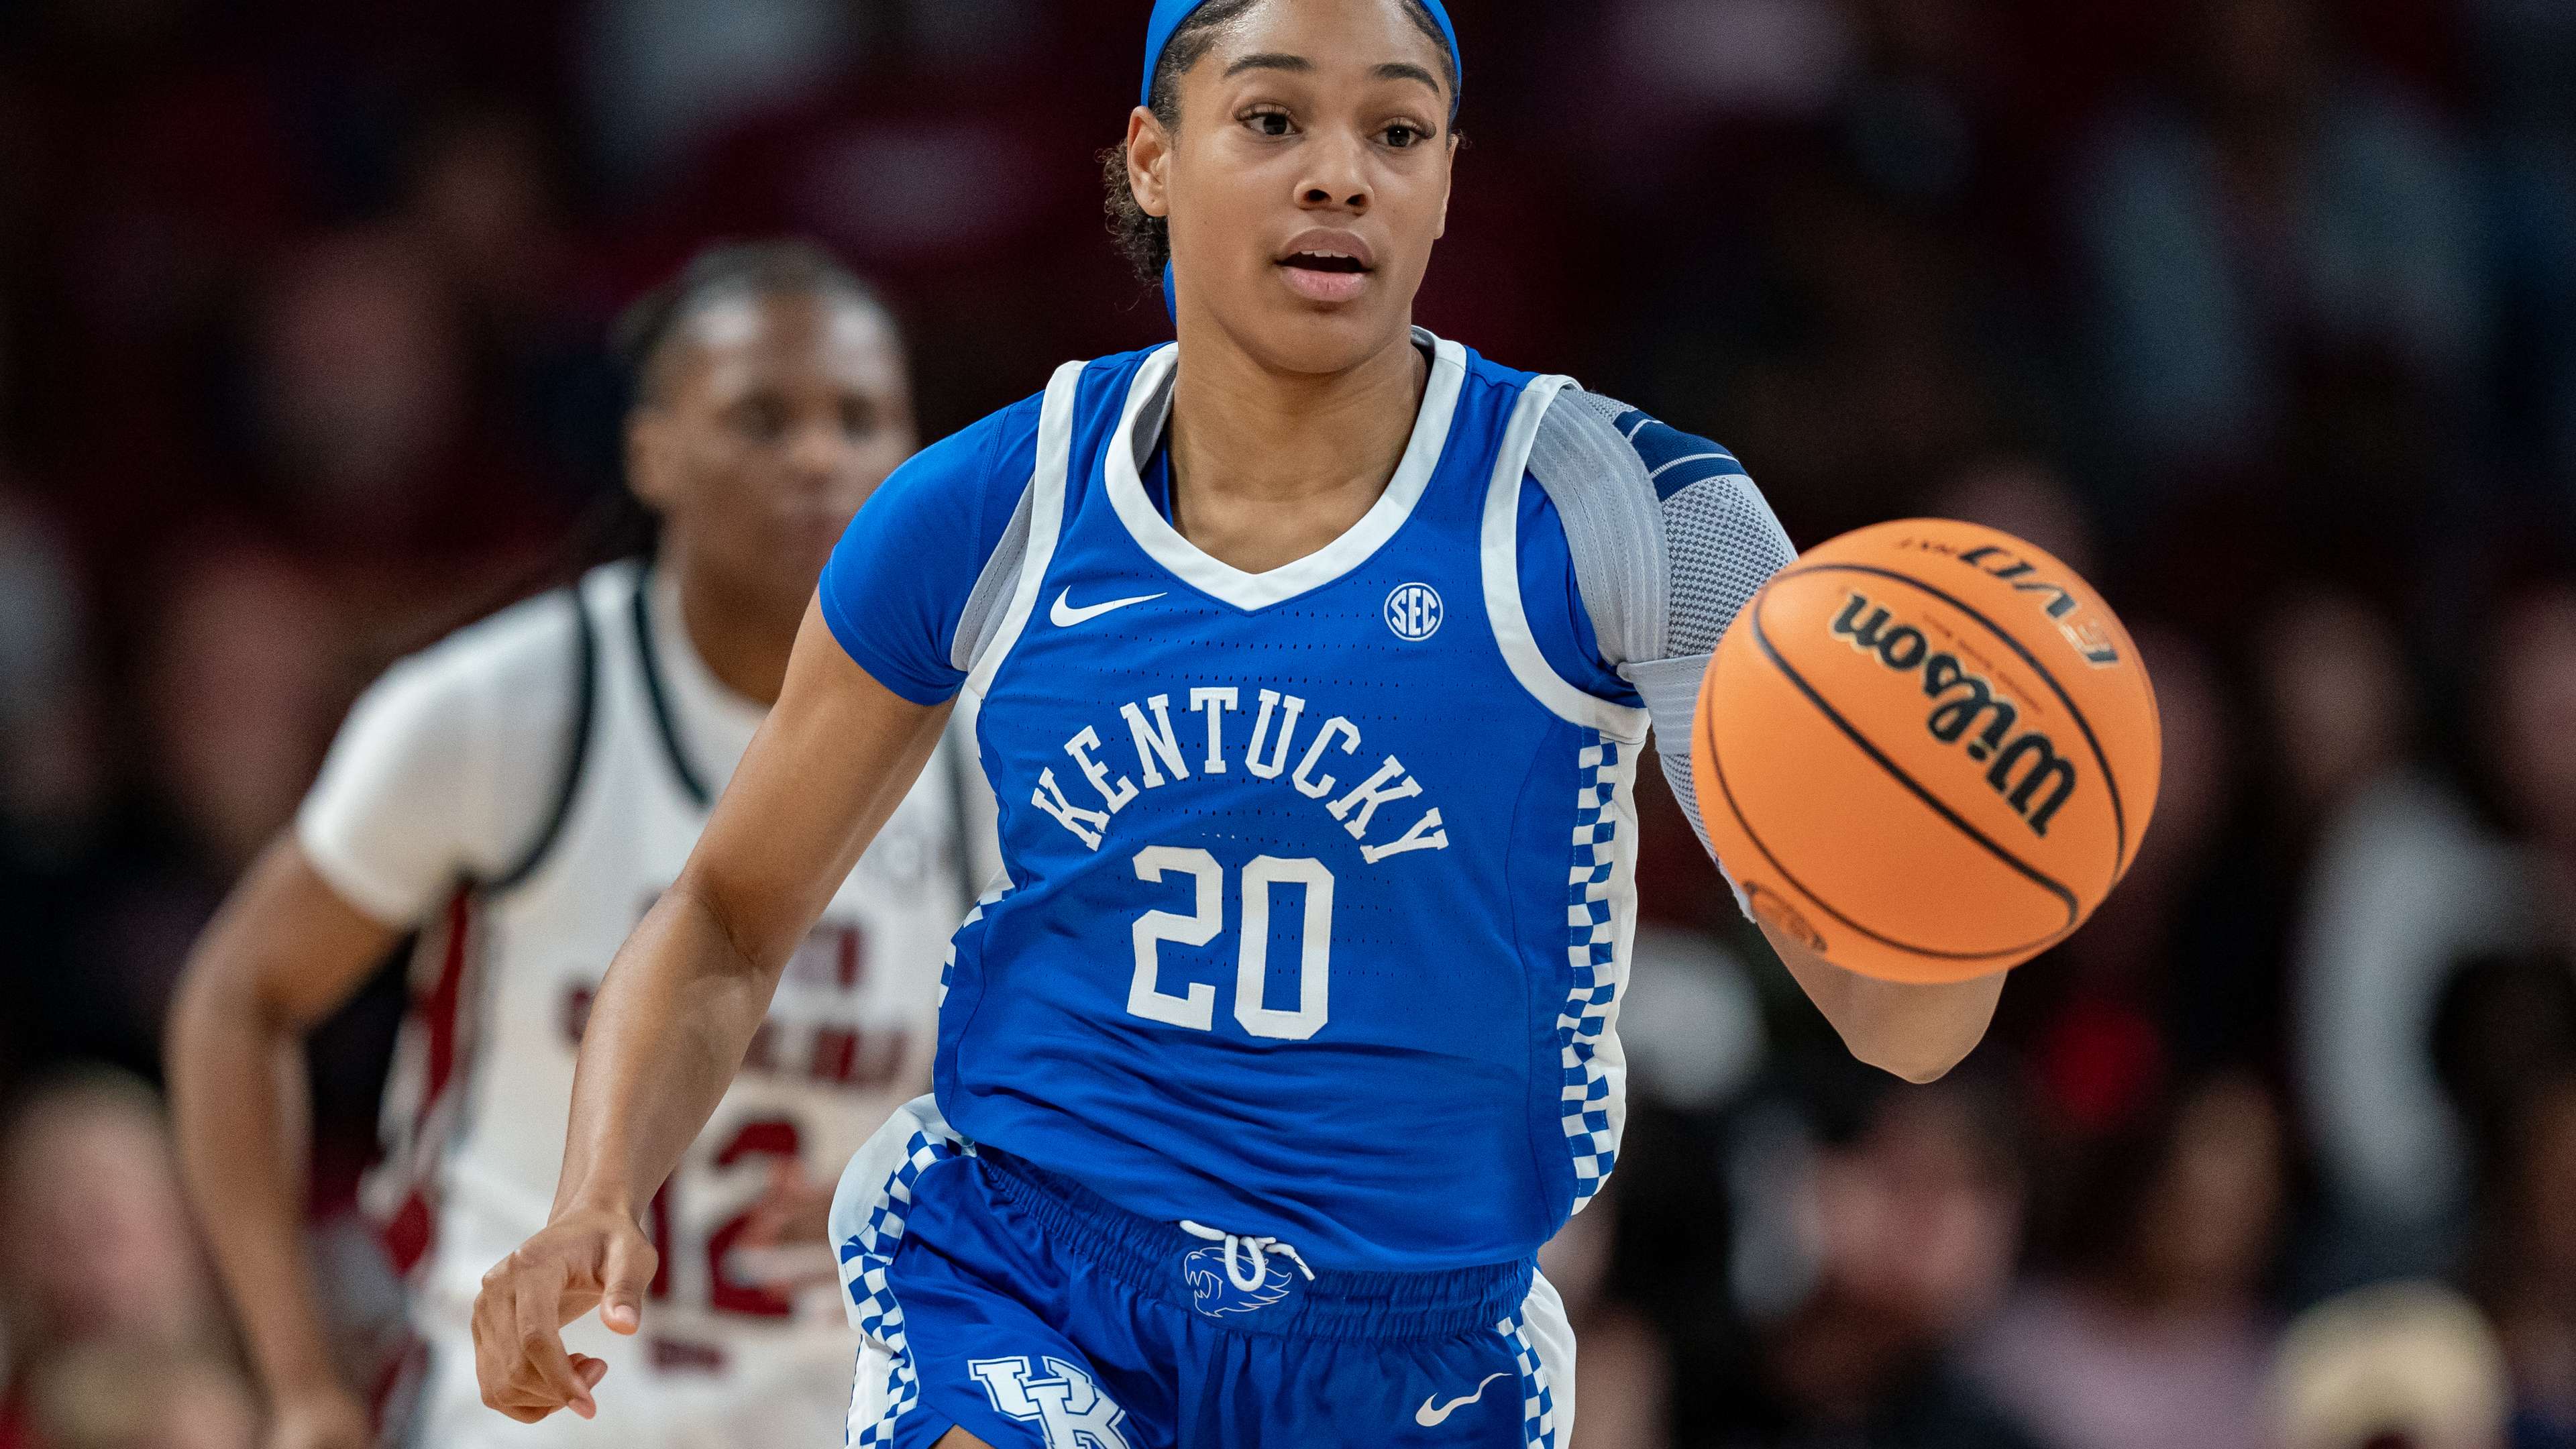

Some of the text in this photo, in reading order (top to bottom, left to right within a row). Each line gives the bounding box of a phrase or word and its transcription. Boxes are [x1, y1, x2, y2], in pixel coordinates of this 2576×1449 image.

[1391, 588, 1438, 635] SEC
[1031, 687, 1449, 864] KENTUCKY
[1830, 593, 2077, 839] Wilson
[1127, 845, 1335, 1040] 20
[967, 1356, 1130, 1449] UK
